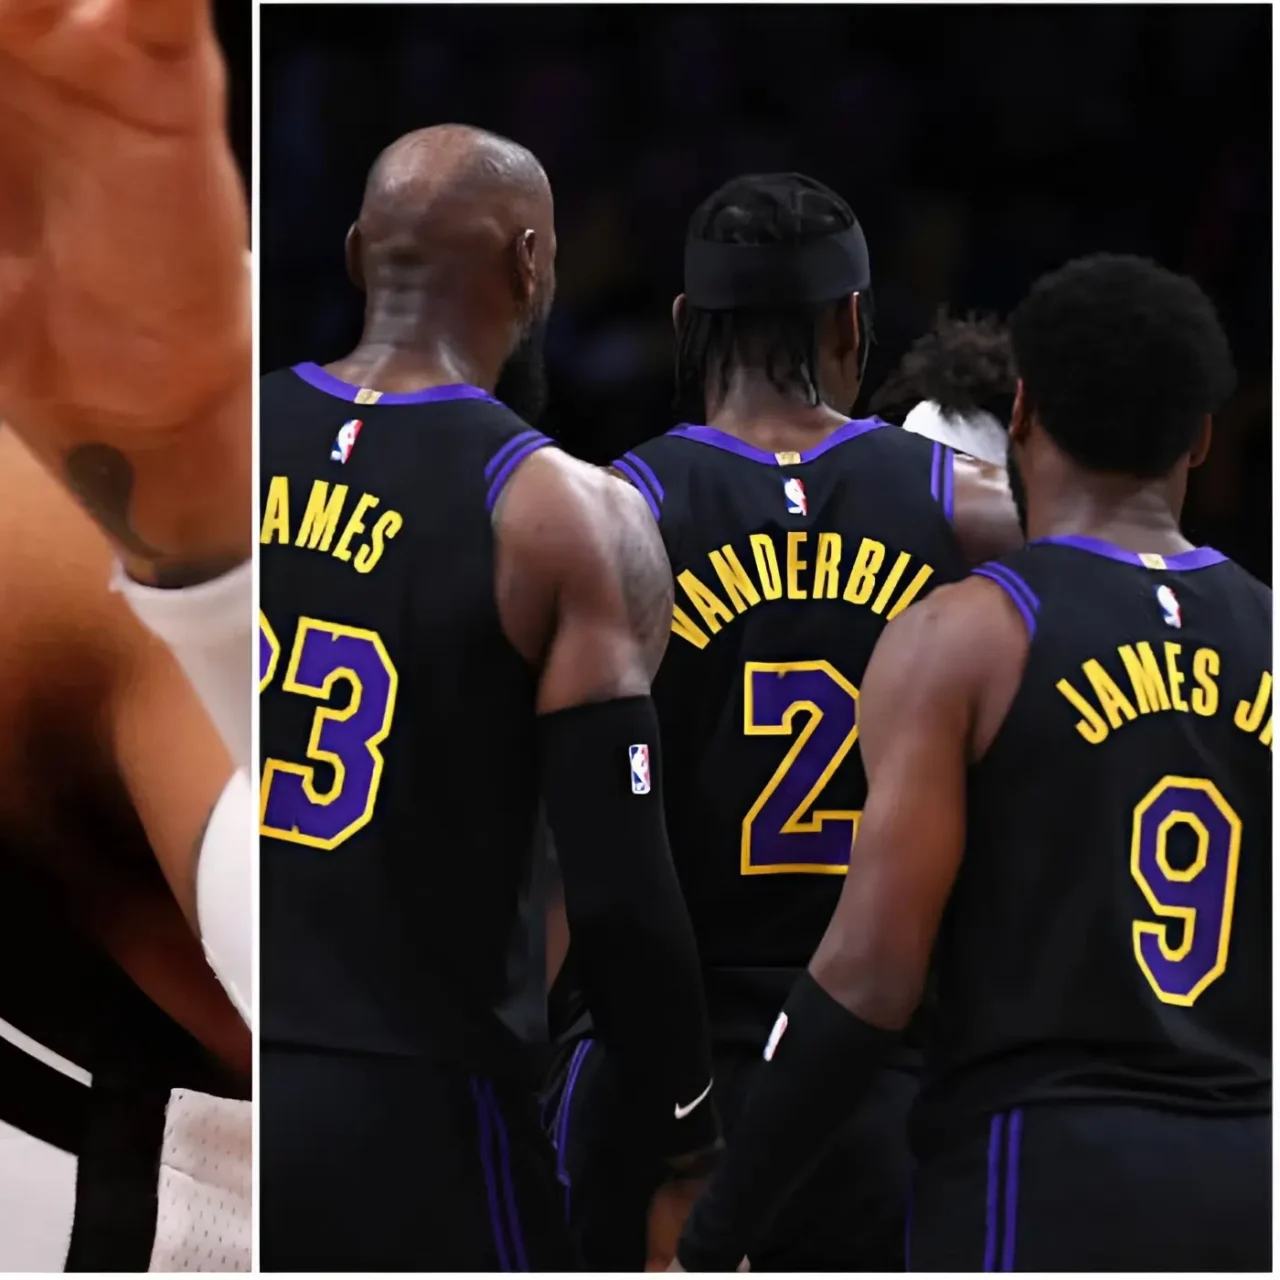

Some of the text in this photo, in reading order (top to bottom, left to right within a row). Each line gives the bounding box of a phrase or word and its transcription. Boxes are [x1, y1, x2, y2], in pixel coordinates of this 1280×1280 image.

[260, 607, 399, 851] 3
[740, 660, 864, 876] 2
[1056, 641, 1272, 752] JAMES J
[1130, 775, 1243, 1007] 9
